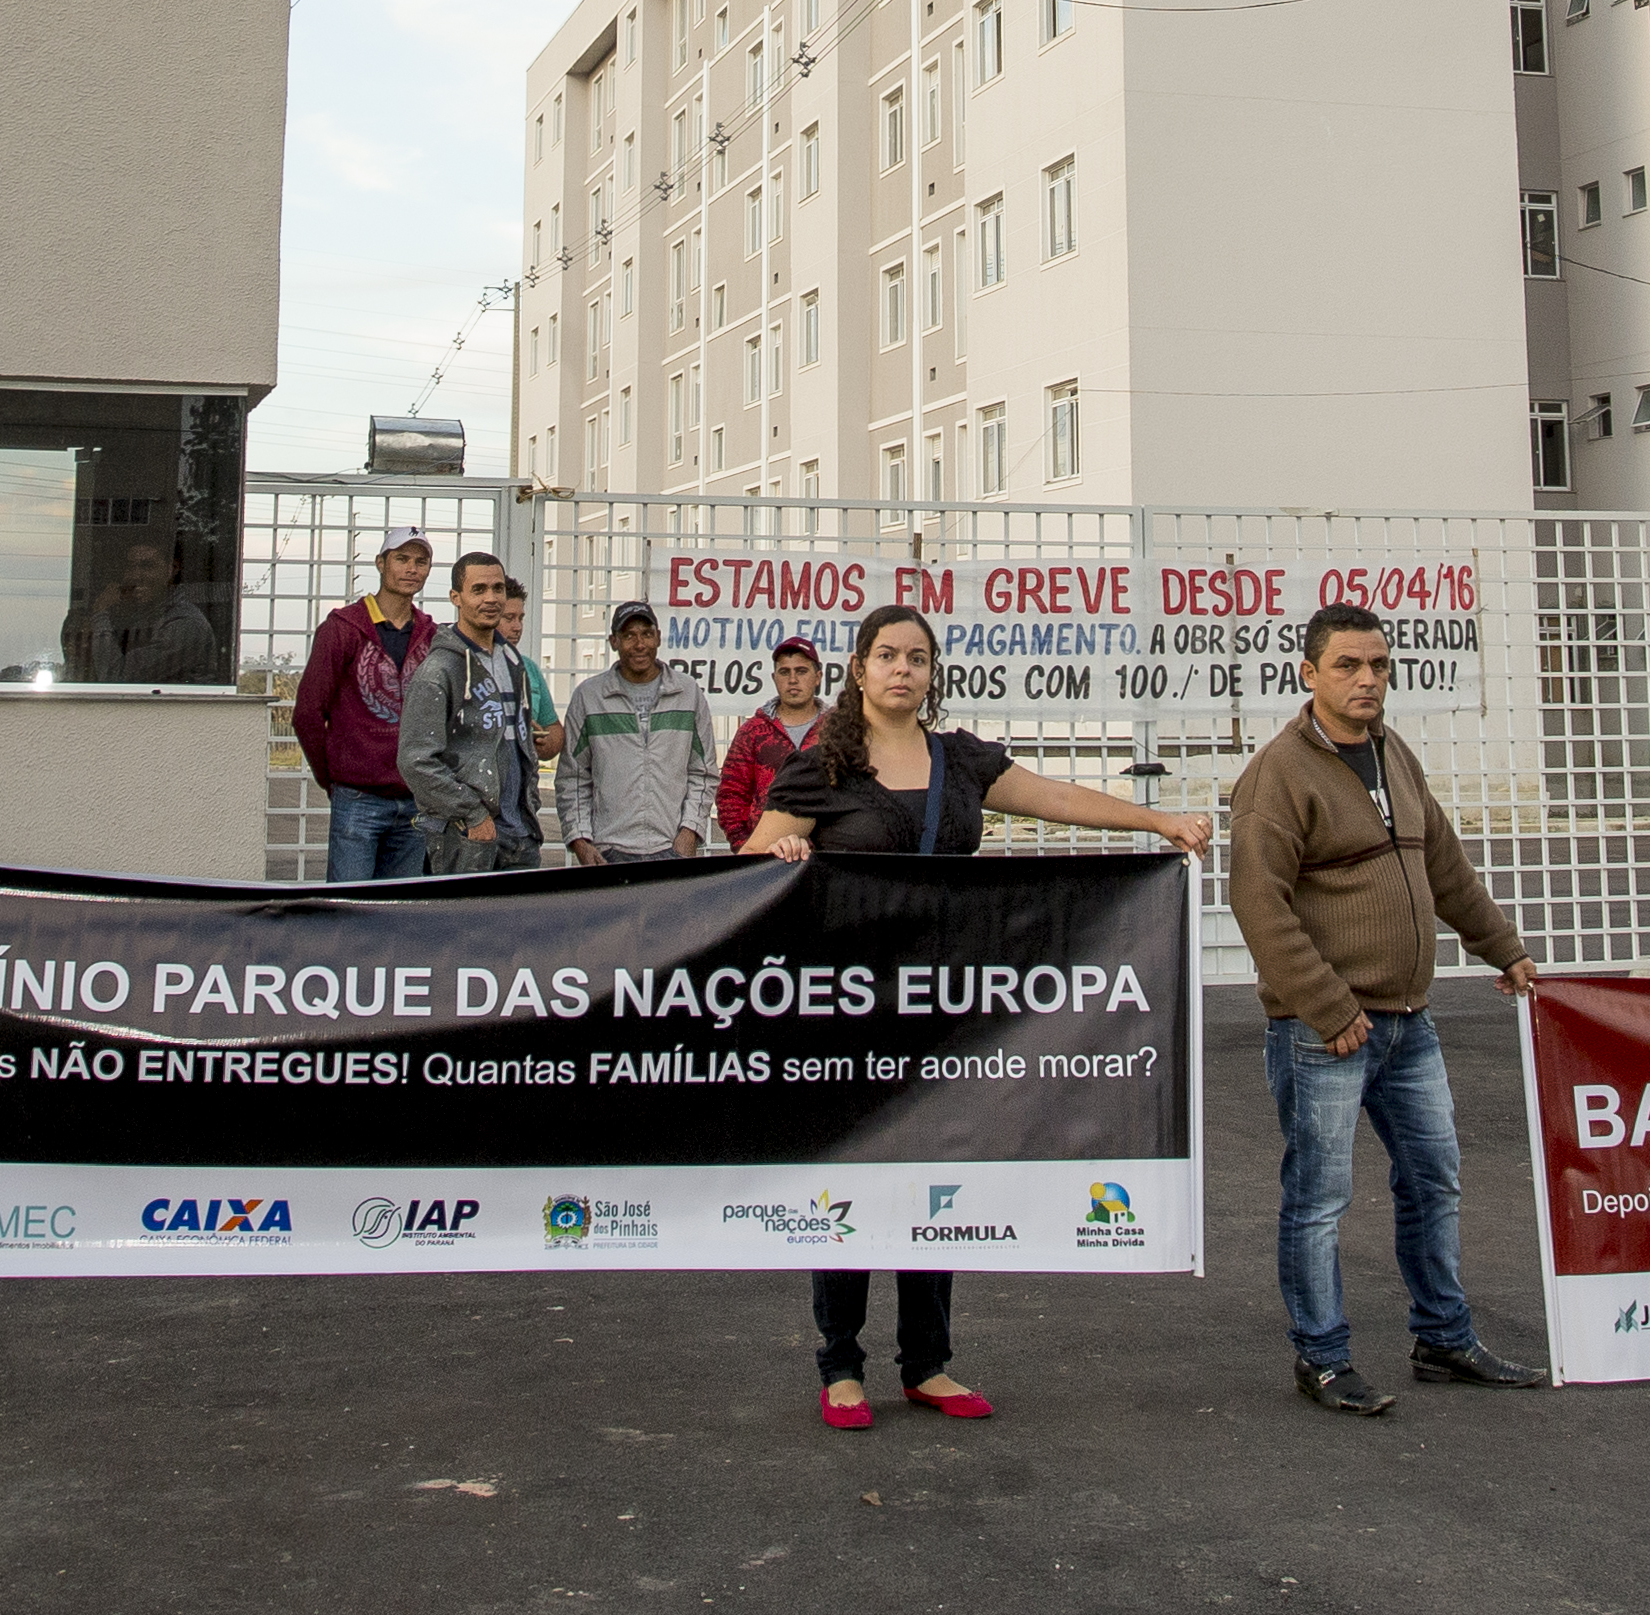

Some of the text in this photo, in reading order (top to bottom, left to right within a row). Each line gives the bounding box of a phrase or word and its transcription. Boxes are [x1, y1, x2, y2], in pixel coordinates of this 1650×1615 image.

[669, 557, 1475, 616] ESTAMOS EM GREVE DESDE 05/04/16
[668, 616, 785, 650] MOTIVO
[797, 619, 861, 653] FALT
[946, 623, 1141, 656] PAGAMENTO.
[1150, 624, 1165, 655] A
[1235, 620, 1273, 654] SÓ
[1381, 618, 1479, 652] BERADA
[1025, 664, 1090, 700] COM
[1210, 663, 1243, 697] DE
[152, 963, 432, 1018] PARQUE
[456, 966, 592, 1018] DAS
[614, 955, 876, 1029] NAÇÕES
[897, 965, 1151, 1016] EUROPA
[30, 1039, 124, 1082] NÃO
[138, 1049, 409, 1084] ENTREGUES!
[423, 1052, 577, 1087] Quantas
[589, 1043, 771, 1084] FAMÍLIAS
[782, 1056, 854, 1082] sem
[864, 1052, 910, 1082] ter
[919, 1048, 1026, 1080] aonde
[1037, 1046, 1158, 1078] morar?
[141, 1198, 293, 1232] CAIXA
[403, 1199, 480, 1231] IAP
[594, 1200, 651, 1218] São José
[723, 1202, 786, 1223] parque
[593, 1219, 658, 1237] dos Pinhais
[764, 1212, 831, 1237] nações
[911, 1224, 1017, 1242] FORMULA
[1076, 1226, 1145, 1236] Minha Casa
[786, 1234, 828, 1246] europa
[1077, 1239, 1109, 1247] Minha
